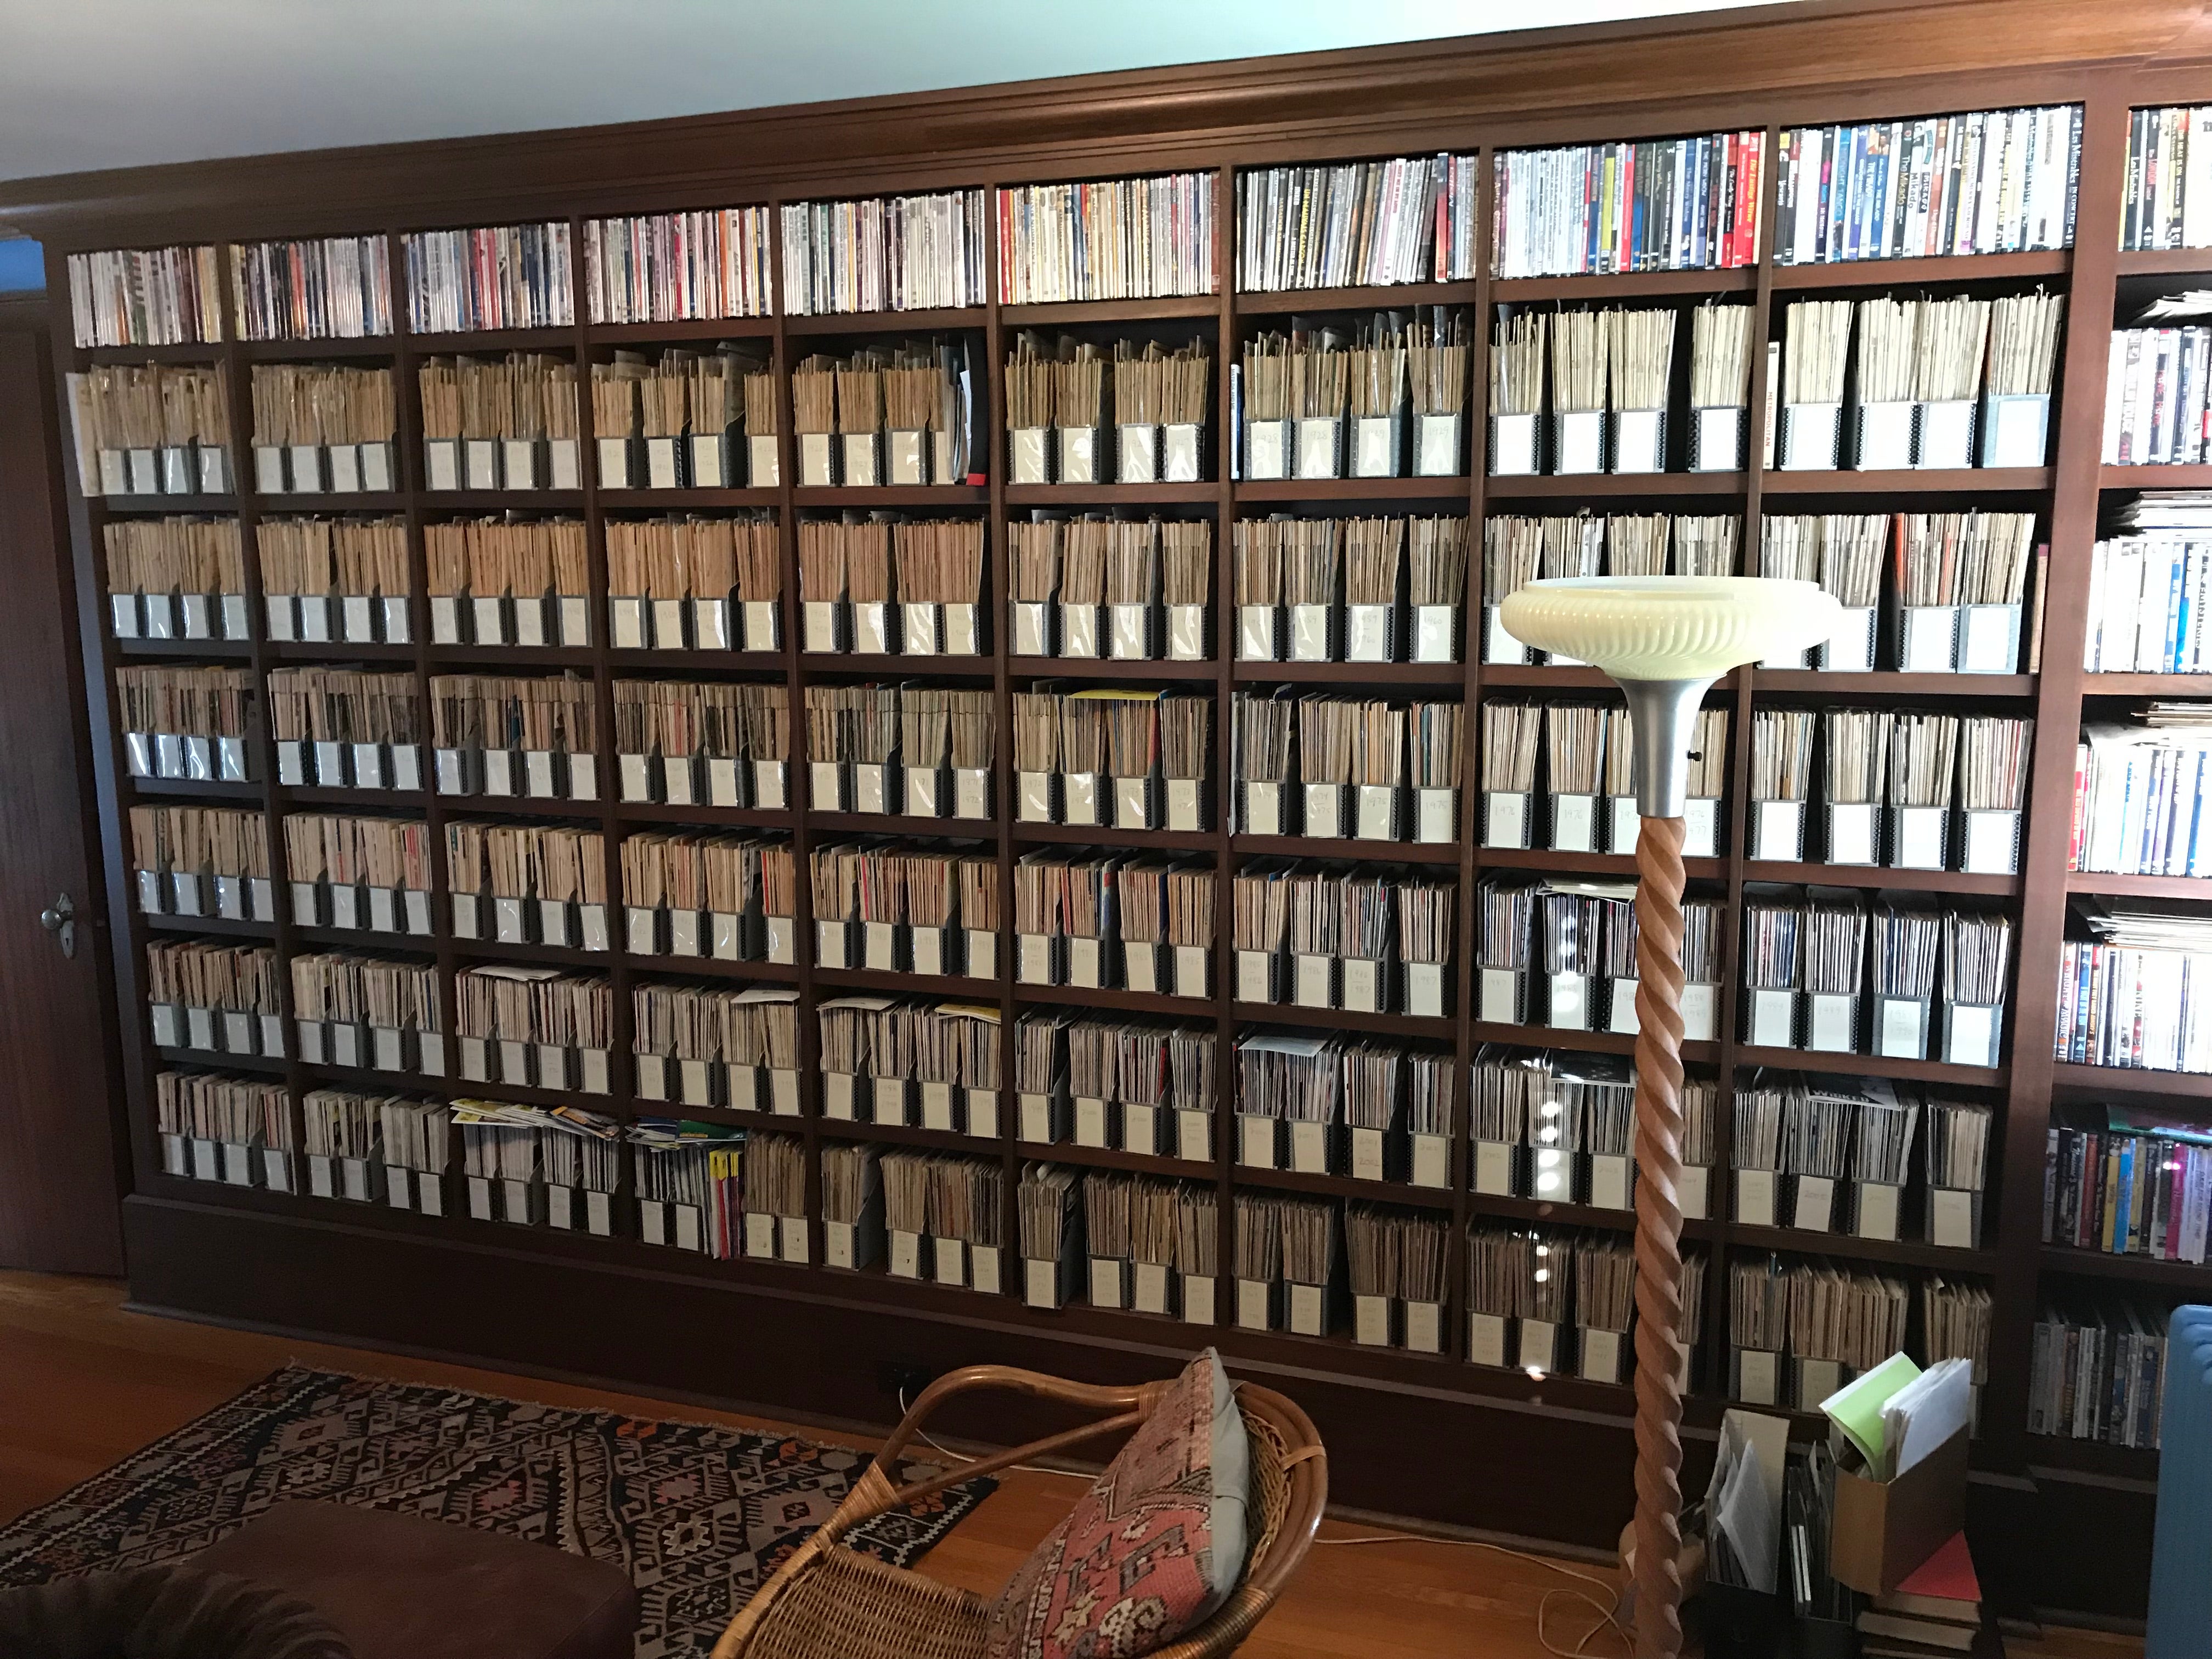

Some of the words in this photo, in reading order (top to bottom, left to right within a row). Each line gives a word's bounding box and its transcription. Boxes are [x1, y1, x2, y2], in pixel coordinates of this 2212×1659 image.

[2073, 131, 2081, 143] Les
[1838, 148, 1848, 185] MIDNIGHT
[1900, 156, 1910, 172] The
[2131, 157, 2140, 168] Les
[2176, 167, 2182, 176] ON
[1747, 173, 1756, 200] Lustige
[1865, 173, 1875, 197] MIKADO
[1897, 172, 1909, 205] Mikado
[1908, 172, 1918, 208] Mikado
[1304, 188, 1311, 199] UN
[1921, 174, 1929, 210] MIKADO
[1836, 188, 1844, 217] TANGO
[2069, 191, 2077, 225] CONCERT
[1306, 431, 1327, 441] 1928
[1429, 427, 1449, 437] 1929
[1424, 616, 1442, 625] 1960
[1024, 780, 1042, 788] 1972
[1122, 788, 1139, 797] 1973
[1311, 792, 1328, 800] 1974
[1366, 798, 1387, 806] 1975
[1426, 801, 1447, 810] 1975
[1495, 806, 1515, 816] 1976
[1565, 809, 1583, 820] 1976
[1302, 966, 1322, 974] 1986
[1415, 977, 1437, 985] 1987
[2063, 973, 2071, 1000] NIGHT
[1618, 991, 1635, 1001] 198
[2059, 1008, 2070, 1038] MAGIC
[1359, 1158, 1379, 1166] 2002
